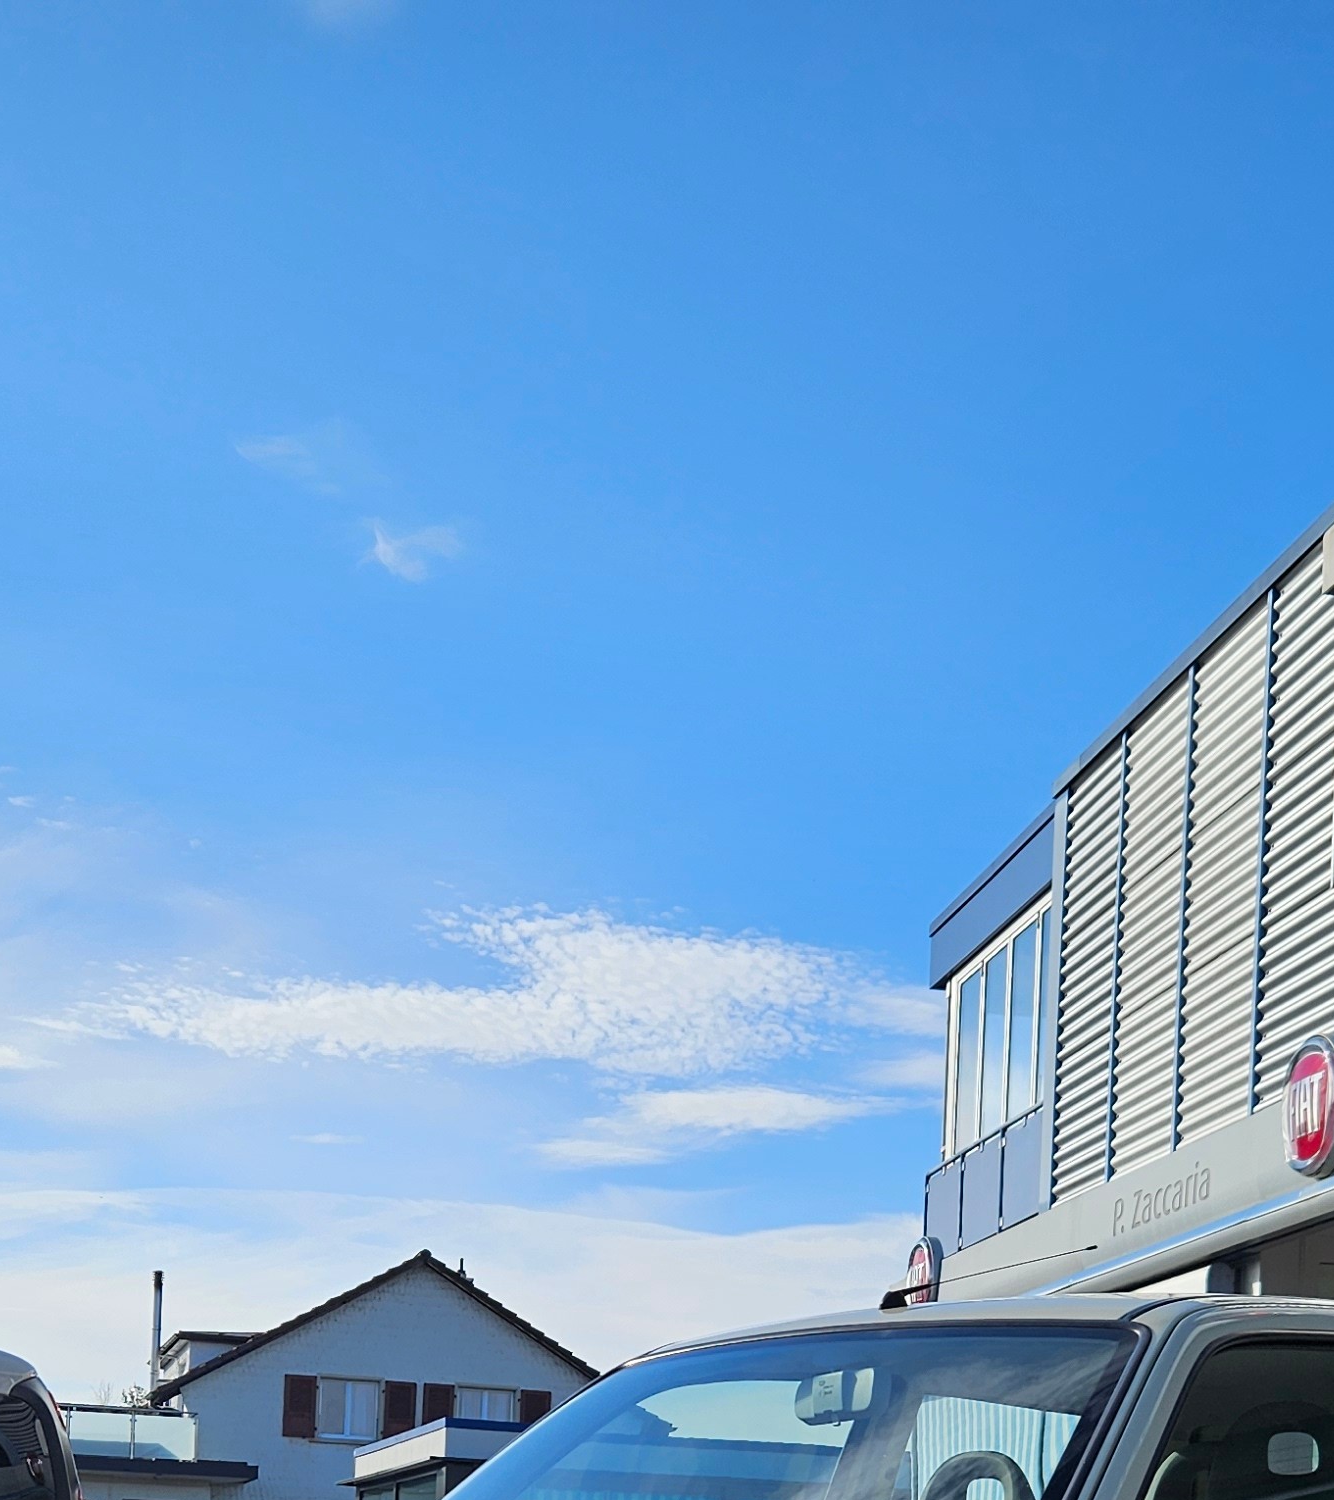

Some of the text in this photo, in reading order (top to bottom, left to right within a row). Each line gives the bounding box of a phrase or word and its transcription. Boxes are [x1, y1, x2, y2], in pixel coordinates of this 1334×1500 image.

[1291, 1070, 1326, 1142] FIAT
[1112, 1160, 1212, 1237] P. Zaccaria
